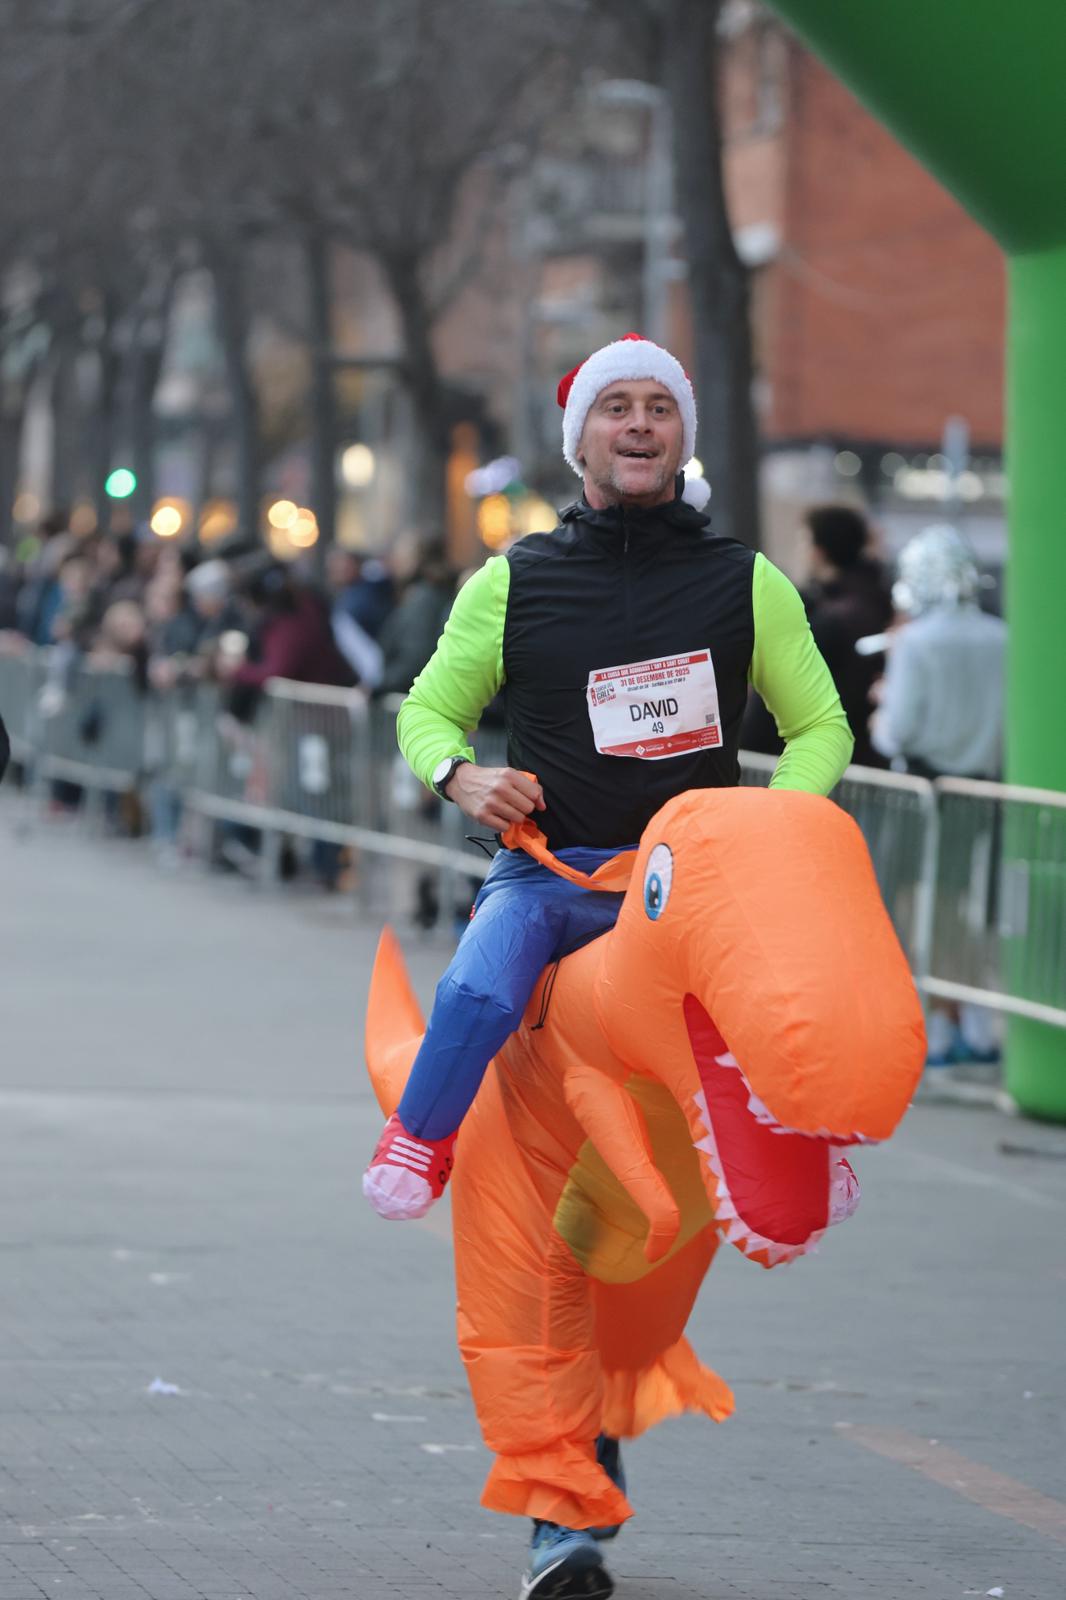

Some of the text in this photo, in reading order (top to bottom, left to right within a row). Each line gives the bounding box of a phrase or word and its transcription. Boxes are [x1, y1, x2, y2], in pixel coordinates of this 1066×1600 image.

[620, 678, 628, 687] 31
[628, 677, 635, 686] DE
[636, 671, 665, 684] DESEMBRE
[666, 669, 674, 678] DE
[674, 666, 690, 677] 2025
[629, 698, 679, 722] DAVID
[652, 721, 664, 734] 49
